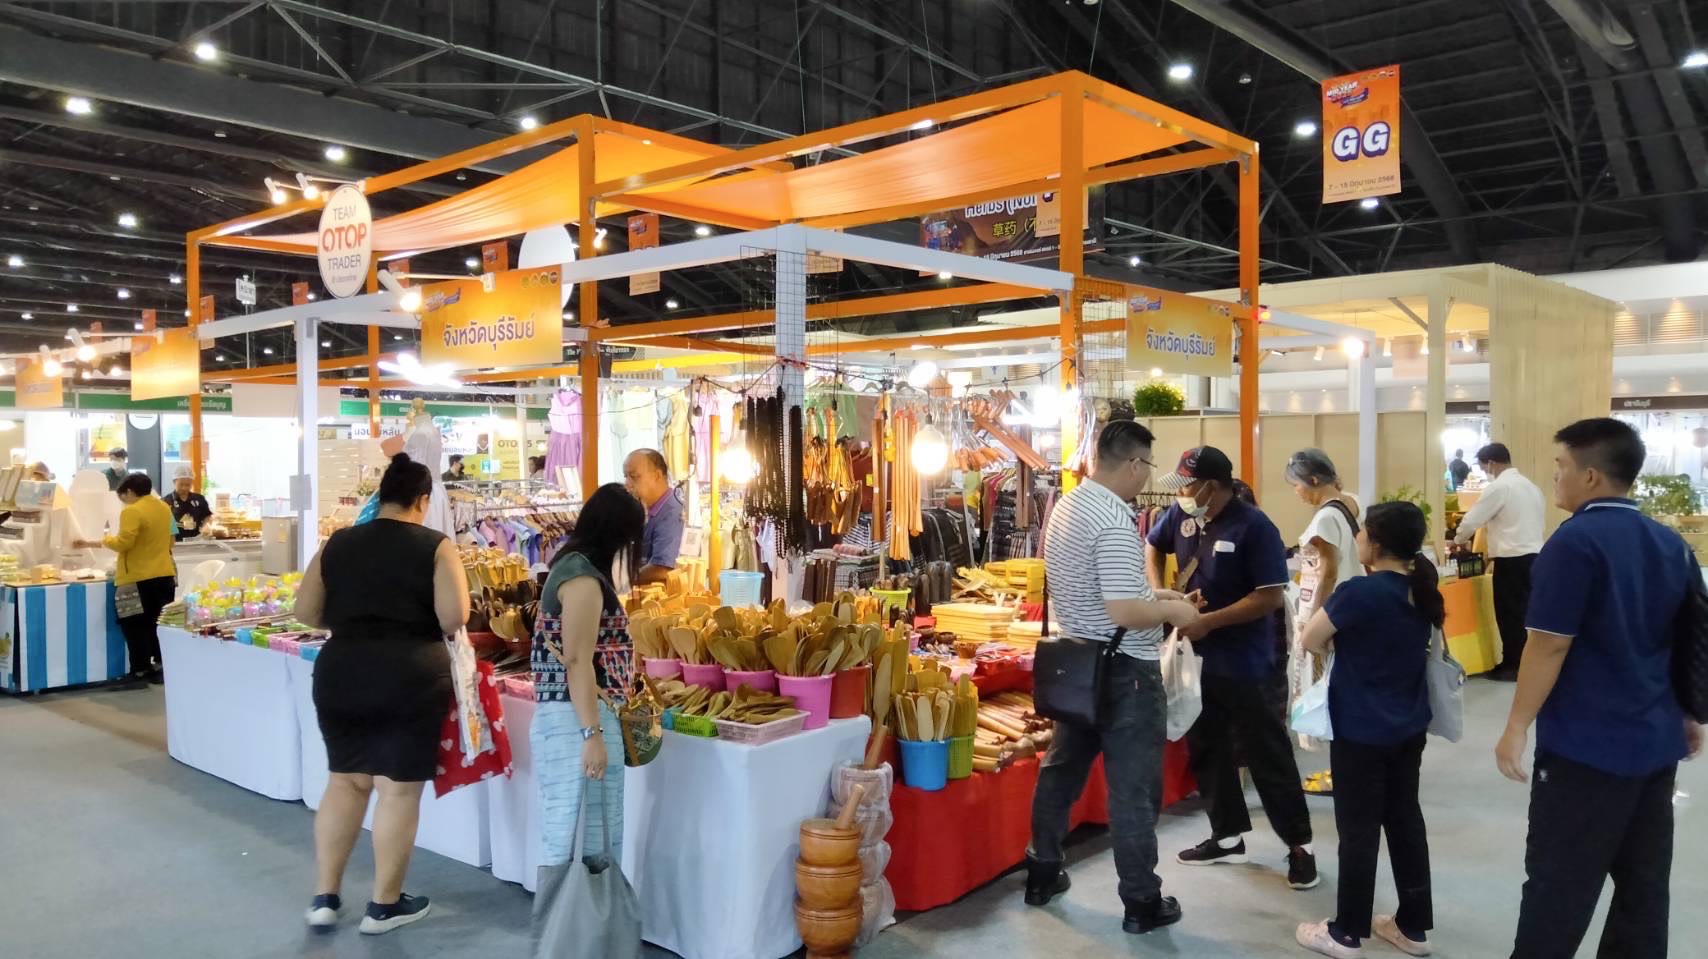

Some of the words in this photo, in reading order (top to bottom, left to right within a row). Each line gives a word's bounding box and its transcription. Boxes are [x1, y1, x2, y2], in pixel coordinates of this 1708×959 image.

[1332, 121, 1390, 161] GG
[333, 206, 357, 220] TEAM
[322, 222, 367, 252] OTOP
[992, 221, 1017, 236] 草药
[328, 254, 361, 270] TRADER
[443, 313, 535, 351] จังหวัดบุรีรัมย์
[1146, 328, 1216, 360] จังหวัดบุรีรัมย์
